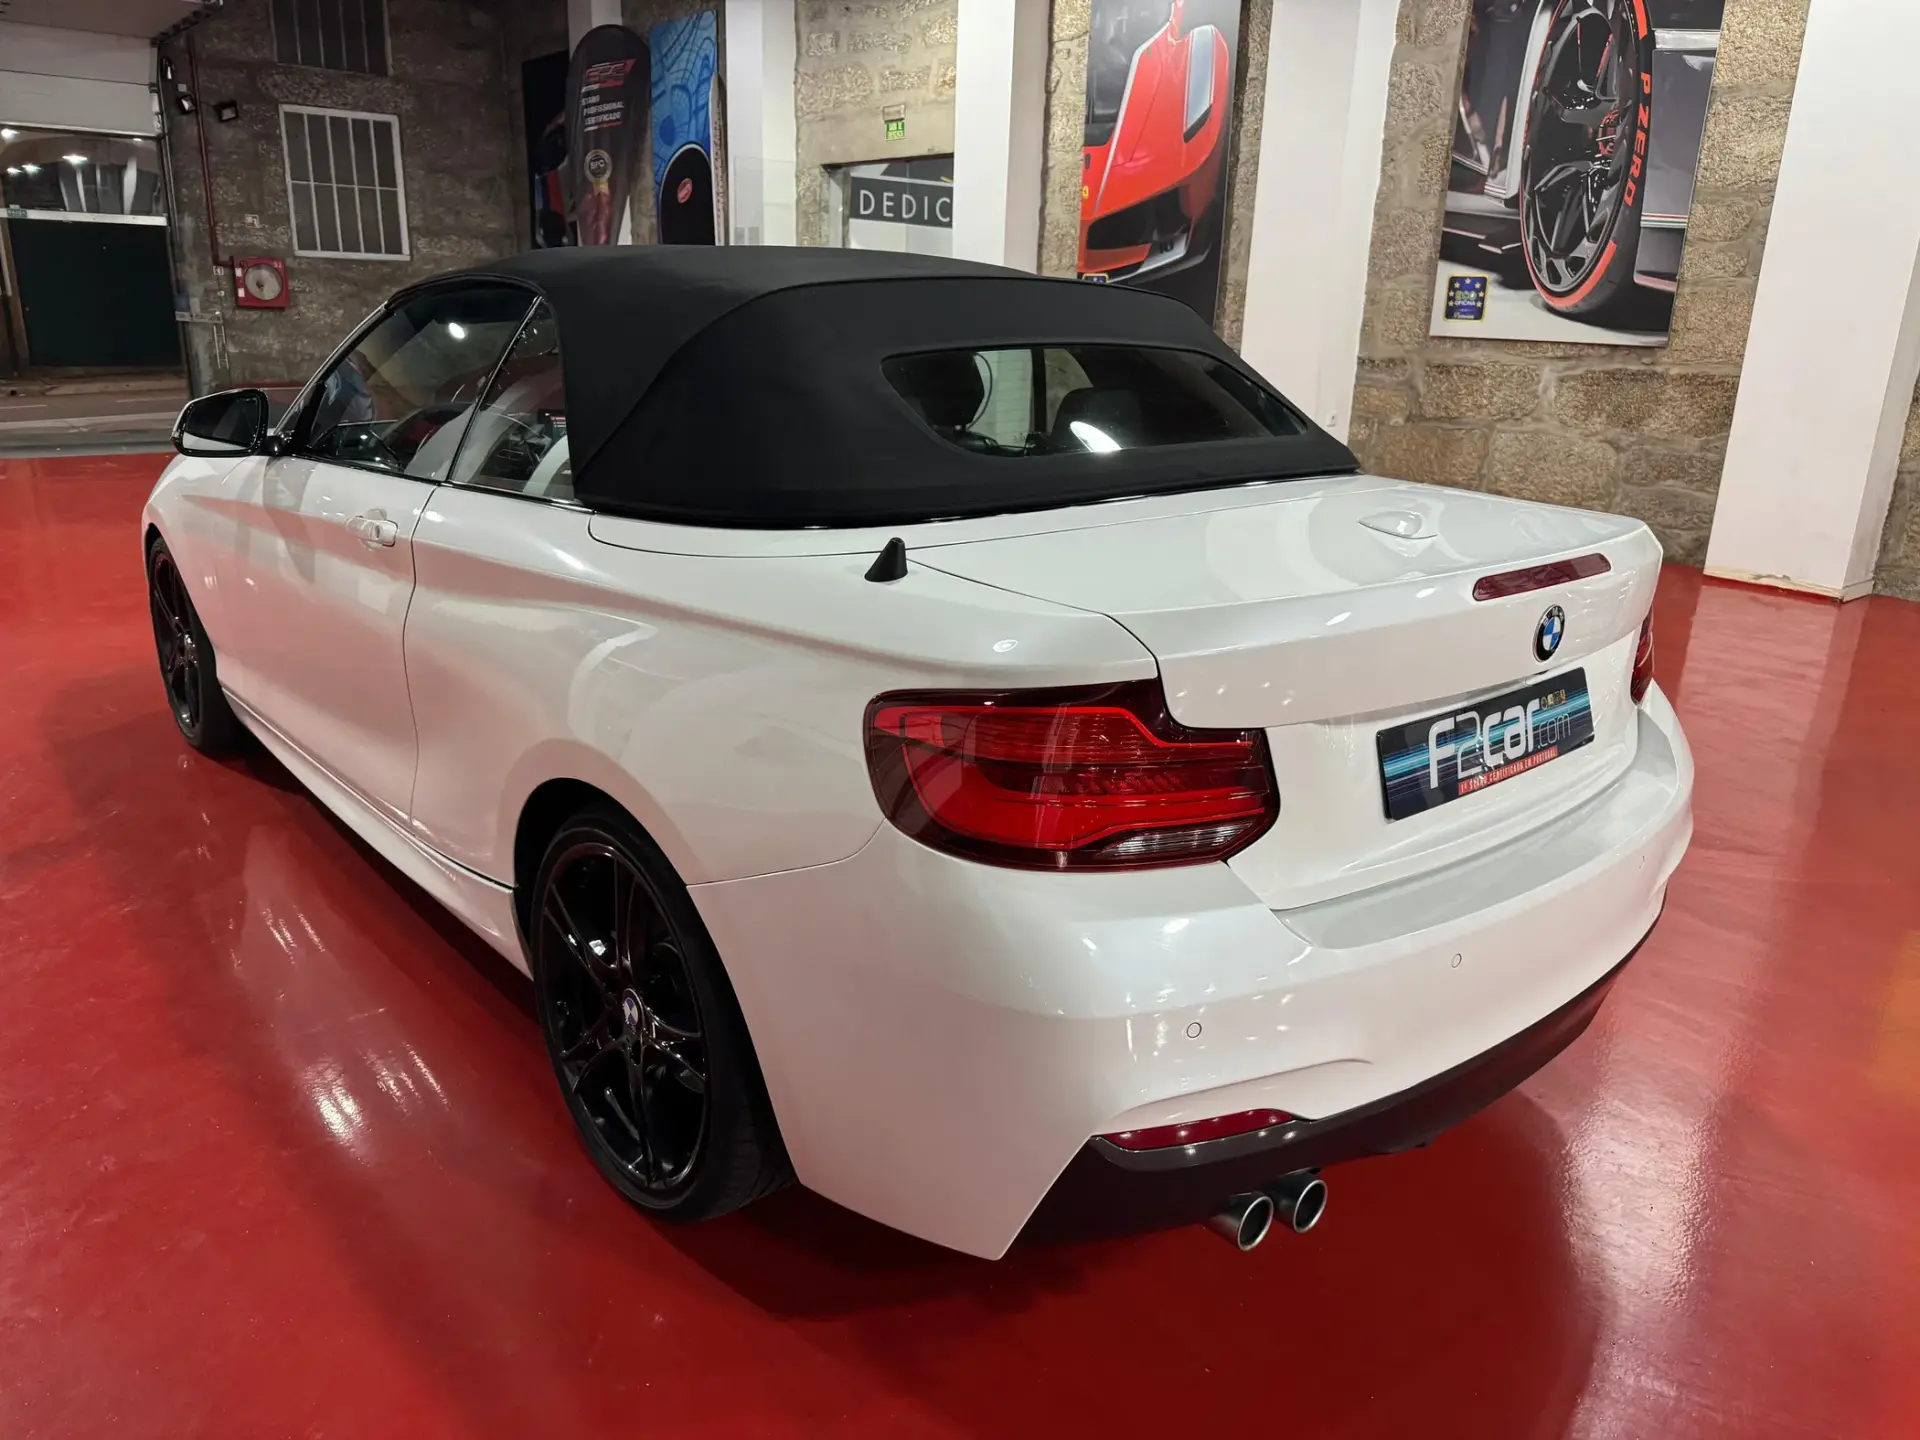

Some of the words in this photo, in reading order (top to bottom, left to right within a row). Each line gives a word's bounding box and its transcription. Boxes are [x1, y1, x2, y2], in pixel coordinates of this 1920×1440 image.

[1641, 72, 1651, 94] P
[1623, 103, 1649, 206] ZERO
[860, 189, 950, 222] DEDIC
